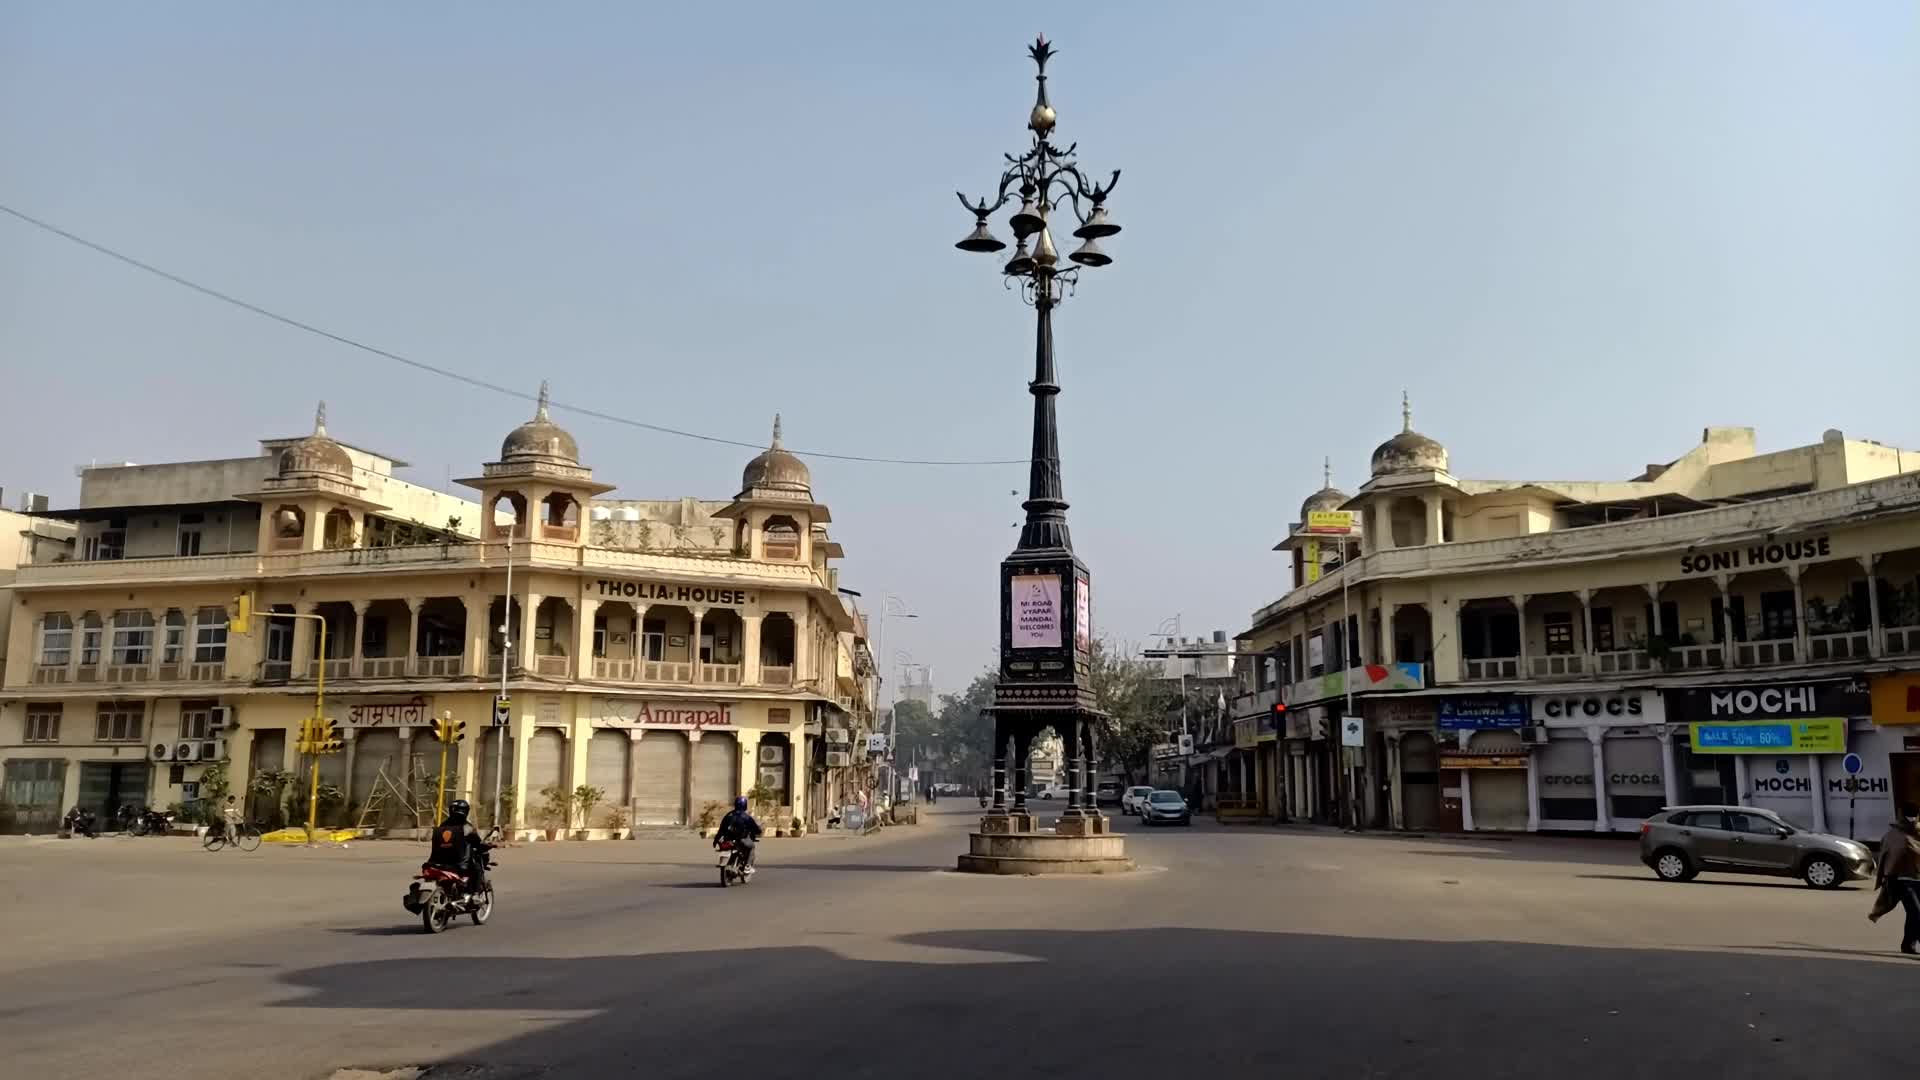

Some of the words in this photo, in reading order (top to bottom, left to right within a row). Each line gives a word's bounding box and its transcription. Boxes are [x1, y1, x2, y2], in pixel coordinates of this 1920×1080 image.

[1681, 551, 1740, 574] SONI
[1748, 536, 1830, 565] HOUSE
[597, 580, 668, 600] THOLIA
[677, 586, 745, 605] HOUSE
[349, 696, 428, 726] आम्रपाली
[1545, 696, 1642, 718] crocs
[1711, 687, 1816, 715] MOCHI
[634, 702, 731, 729] Amrapali
[1545, 775, 1593, 785] crocs
[1611, 773, 1660, 785] crocs
